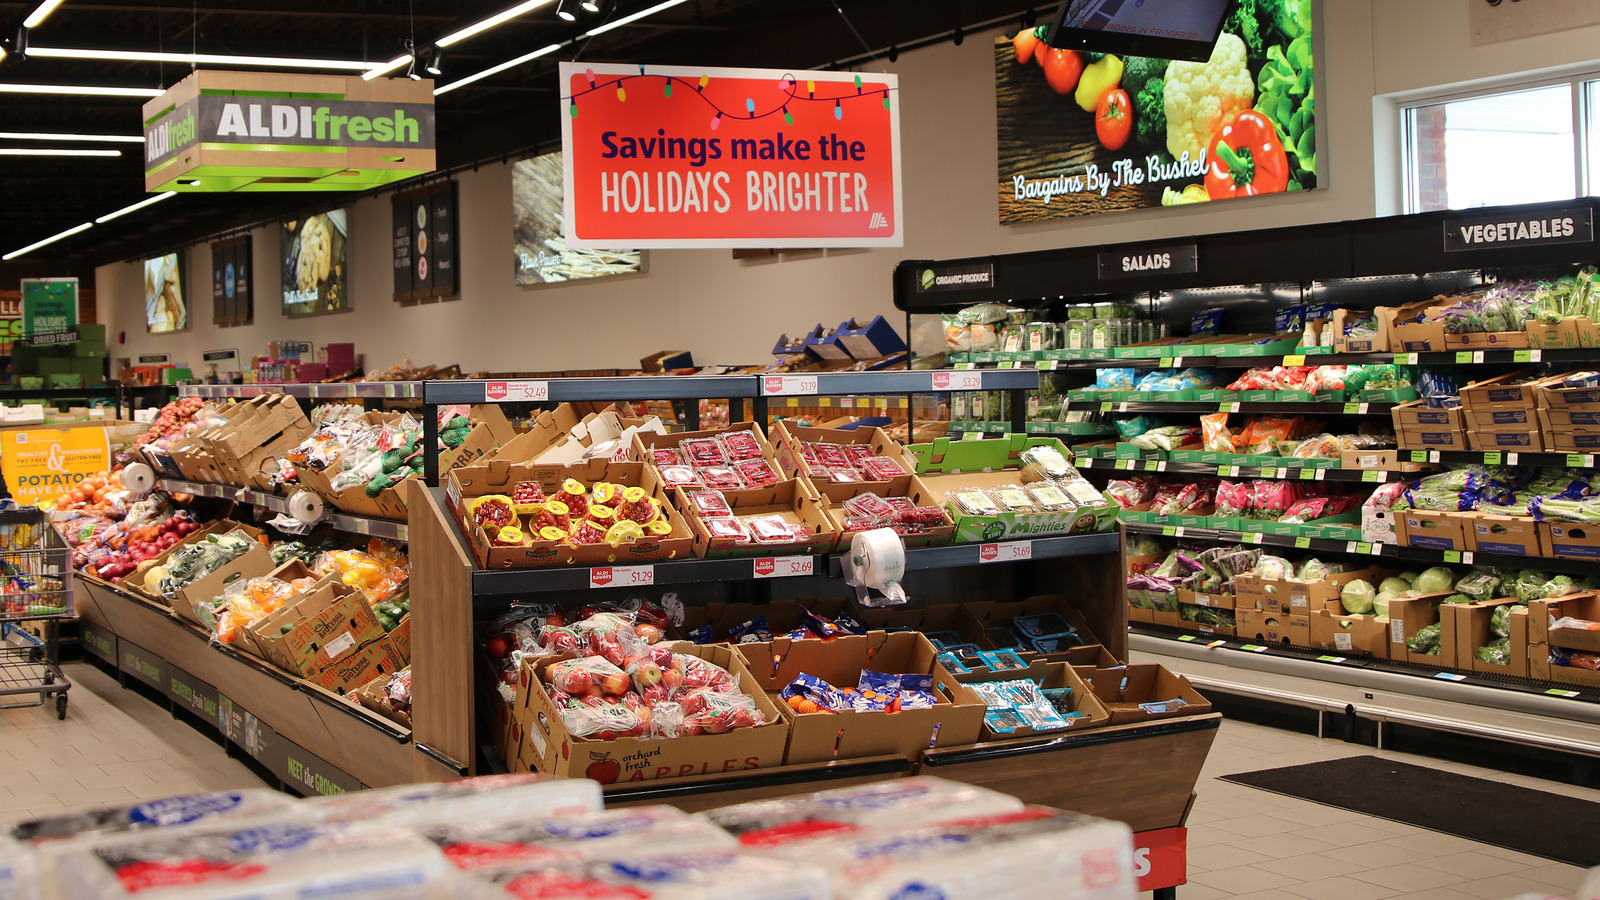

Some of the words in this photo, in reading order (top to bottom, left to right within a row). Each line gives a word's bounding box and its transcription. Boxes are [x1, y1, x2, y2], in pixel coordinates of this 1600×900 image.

[1150, 28, 1199, 40] PROGRESS
[216, 103, 419, 142] ALDIfresh
[148, 108, 195, 162] ALDIfresh
[601, 128, 722, 167] Savings
[731, 132, 811, 160] make
[818, 133, 866, 161] the
[1013, 174, 1084, 204] Bargains
[1085, 164, 1111, 197] By
[1112, 159, 1145, 188] The
[1145, 148, 1210, 183] Bushel
[601, 170, 731, 213] HOLIDAYS
[746, 170, 869, 213] BRIGHTER
[1460, 217, 1574, 244] VEGETABLES
[1122, 253, 1171, 272] SALADS
[936, 275, 962, 285] ORGANIC
[962, 273, 989, 283] PRODUCE
[33, 316, 67, 326] HOLIDAYS
[33, 334, 56, 344] DRIED
[56, 332, 77, 342] FRUIT
[800, 381, 816, 392] $1.19
[963, 377, 980, 387] $3.29
[524, 387, 546, 398] $2.49
[18, 486, 52, 496] HAVE
[1010, 521, 1067, 534] Mighties
[1013, 546, 1030, 557] $1.69
[791, 561, 812, 573] $2.69
[631, 571, 652, 583] $1.29
[171, 677, 192, 703] DELIVERED
[192, 689, 203, 709] fresh
[203, 696, 216, 718] DAILY
[622, 746, 661, 763] orchard
[625, 757, 651, 773] fresh
[629, 756, 760, 783] APPLES
[288, 756, 303, 781] MEET
[304, 767, 314, 789] the
